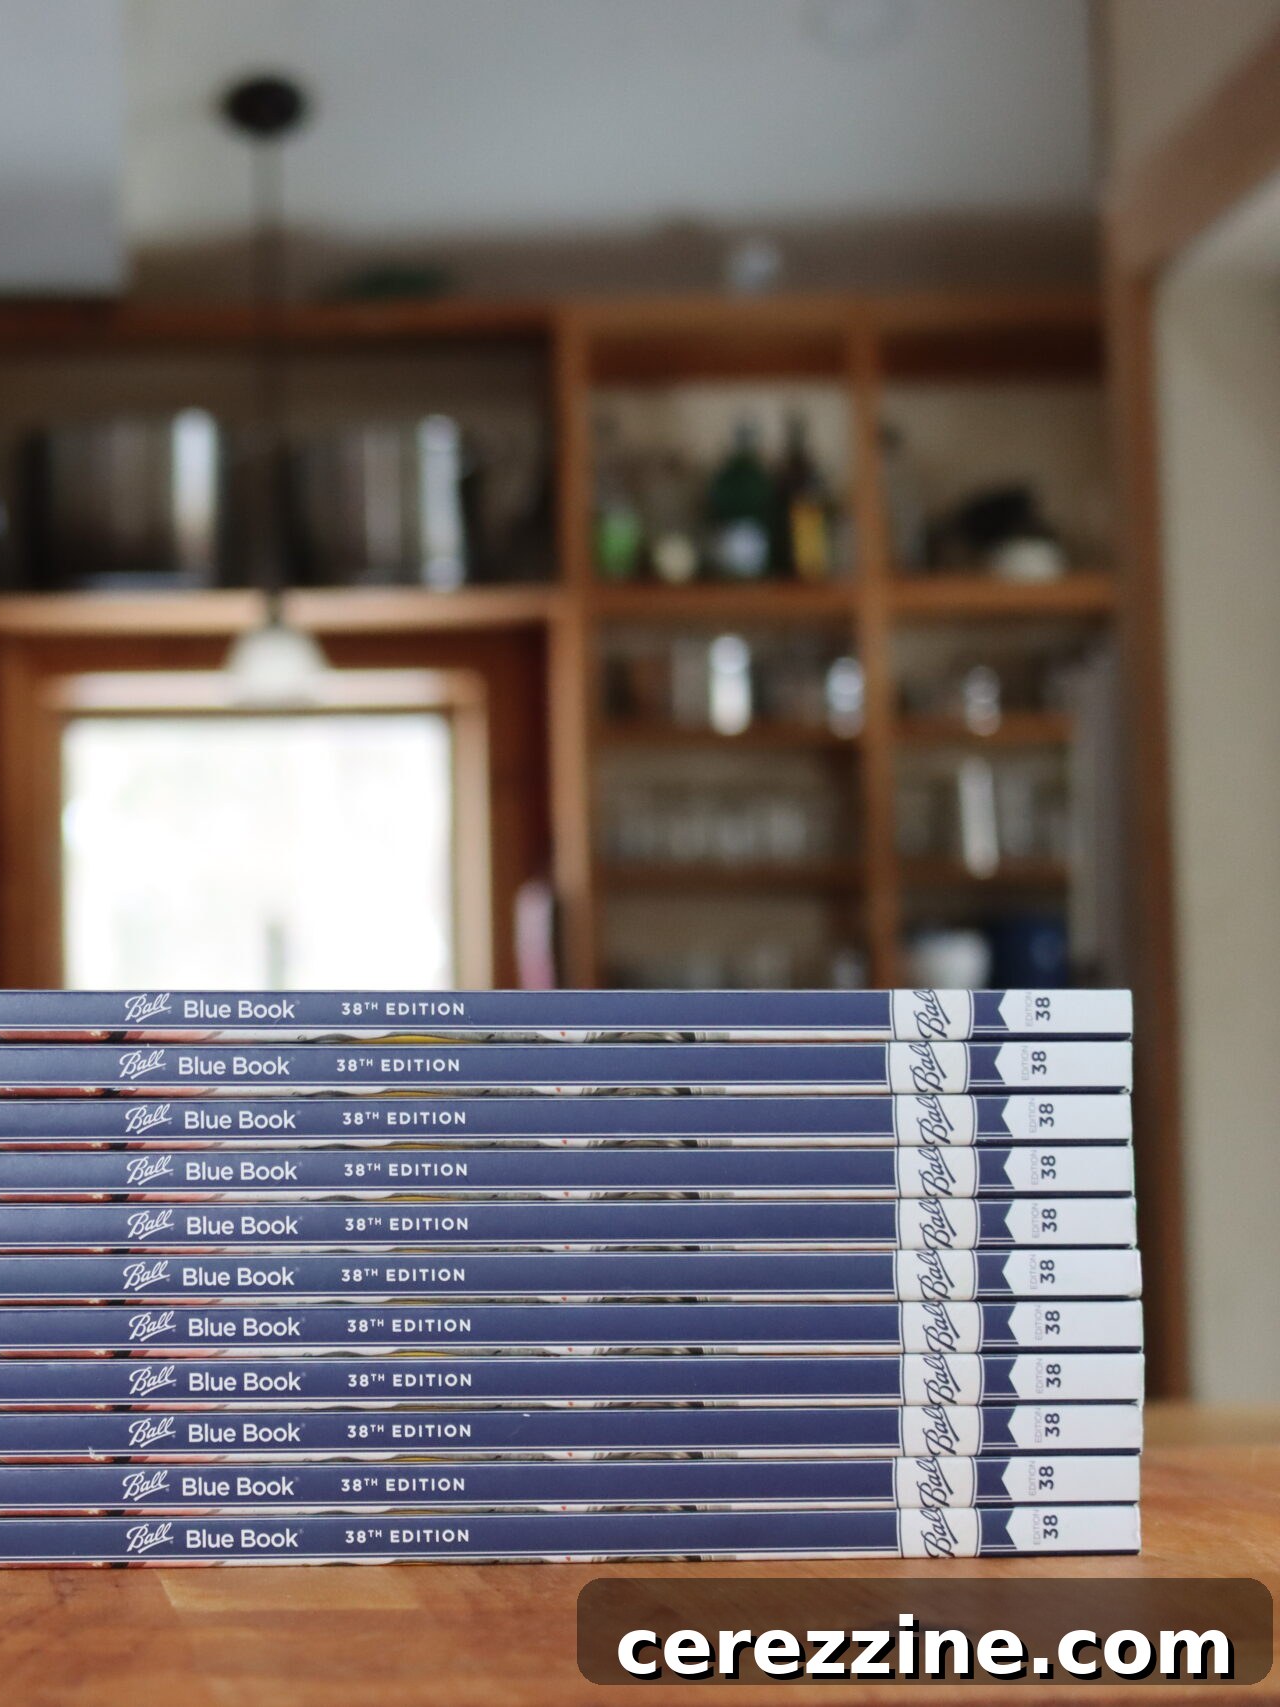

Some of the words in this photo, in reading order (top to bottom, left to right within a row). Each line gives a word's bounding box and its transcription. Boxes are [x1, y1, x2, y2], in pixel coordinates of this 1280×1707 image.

[124, 992, 172, 1024] Ball
[183, 999, 232, 1019] Blue
[238, 999, 295, 1019] Book
[341, 1001, 378, 1016] 38TH
[386, 1002, 465, 1016] EDITION
[1035, 997, 1051, 1021] 38
[119, 1048, 167, 1080] Ball
[178, 1055, 227, 1075] Blue
[232, 1055, 290, 1075] Book
[336, 1058, 373, 1072] 38TH
[381, 1058, 460, 1072] EDITION
[1031, 1050, 1047, 1075] 38
[125, 1103, 173, 1135] Ball
[184, 1110, 232, 1130] Blue
[238, 1109, 296, 1129] Book
[342, 1111, 380, 1125] 38TH
[387, 1111, 466, 1125] EDITION
[1038, 1103, 1055, 1127] 38
[126, 1154, 174, 1186] Ball
[185, 1161, 234, 1181] Blue
[240, 1160, 298, 1181] Book
[344, 1163, 381, 1177] 38TH
[388, 1163, 468, 1177] EDITION
[1040, 1155, 1057, 1180] 38
[127, 1208, 175, 1240] Ball
[186, 1215, 235, 1235] Blue
[241, 1215, 298, 1235] Book
[345, 1217, 382, 1231] 38TH
[389, 1217, 468, 1231] EDITION
[1041, 1208, 1058, 1233] 38
[123, 1259, 171, 1291] Ball
[182, 1266, 231, 1286] Blue
[237, 1266, 295, 1286] Book
[341, 1268, 378, 1282] 38TH
[386, 1268, 465, 1282] EDITION
[1039, 1259, 1056, 1284] 38
[129, 1310, 177, 1342] Ball
[188, 1317, 237, 1337] Blue
[243, 1316, 301, 1337] Book
[347, 1318, 384, 1333] 38TH
[392, 1319, 471, 1333] EDITION
[1044, 1310, 1061, 1335] 38
[130, 1364, 178, 1396] Ball
[189, 1371, 237, 1392] Blue
[243, 1371, 301, 1391] Book
[348, 1373, 385, 1387] 38TH
[392, 1373, 472, 1387] EDITION
[1045, 1363, 1062, 1388] 38
[129, 1416, 177, 1448] Ball
[188, 1423, 237, 1443] Blue
[243, 1422, 301, 1442] Book
[347, 1424, 384, 1438] 38TH
[392, 1424, 471, 1438] EDITION
[1044, 1412, 1061, 1437] 38
[123, 1469, 171, 1501] Ball
[182, 1476, 230, 1496] Blue
[236, 1476, 294, 1496] Book
[341, 1478, 378, 1492] 38TH
[385, 1478, 465, 1492] EDITION
[1038, 1465, 1055, 1490] 38
[127, 1522, 175, 1554] Ball
[186, 1529, 235, 1549] Blue
[240, 1528, 298, 1548] Book
[345, 1529, 382, 1544] 38TH
[390, 1529, 469, 1543] EDITION
[1042, 1514, 1059, 1539] 38
